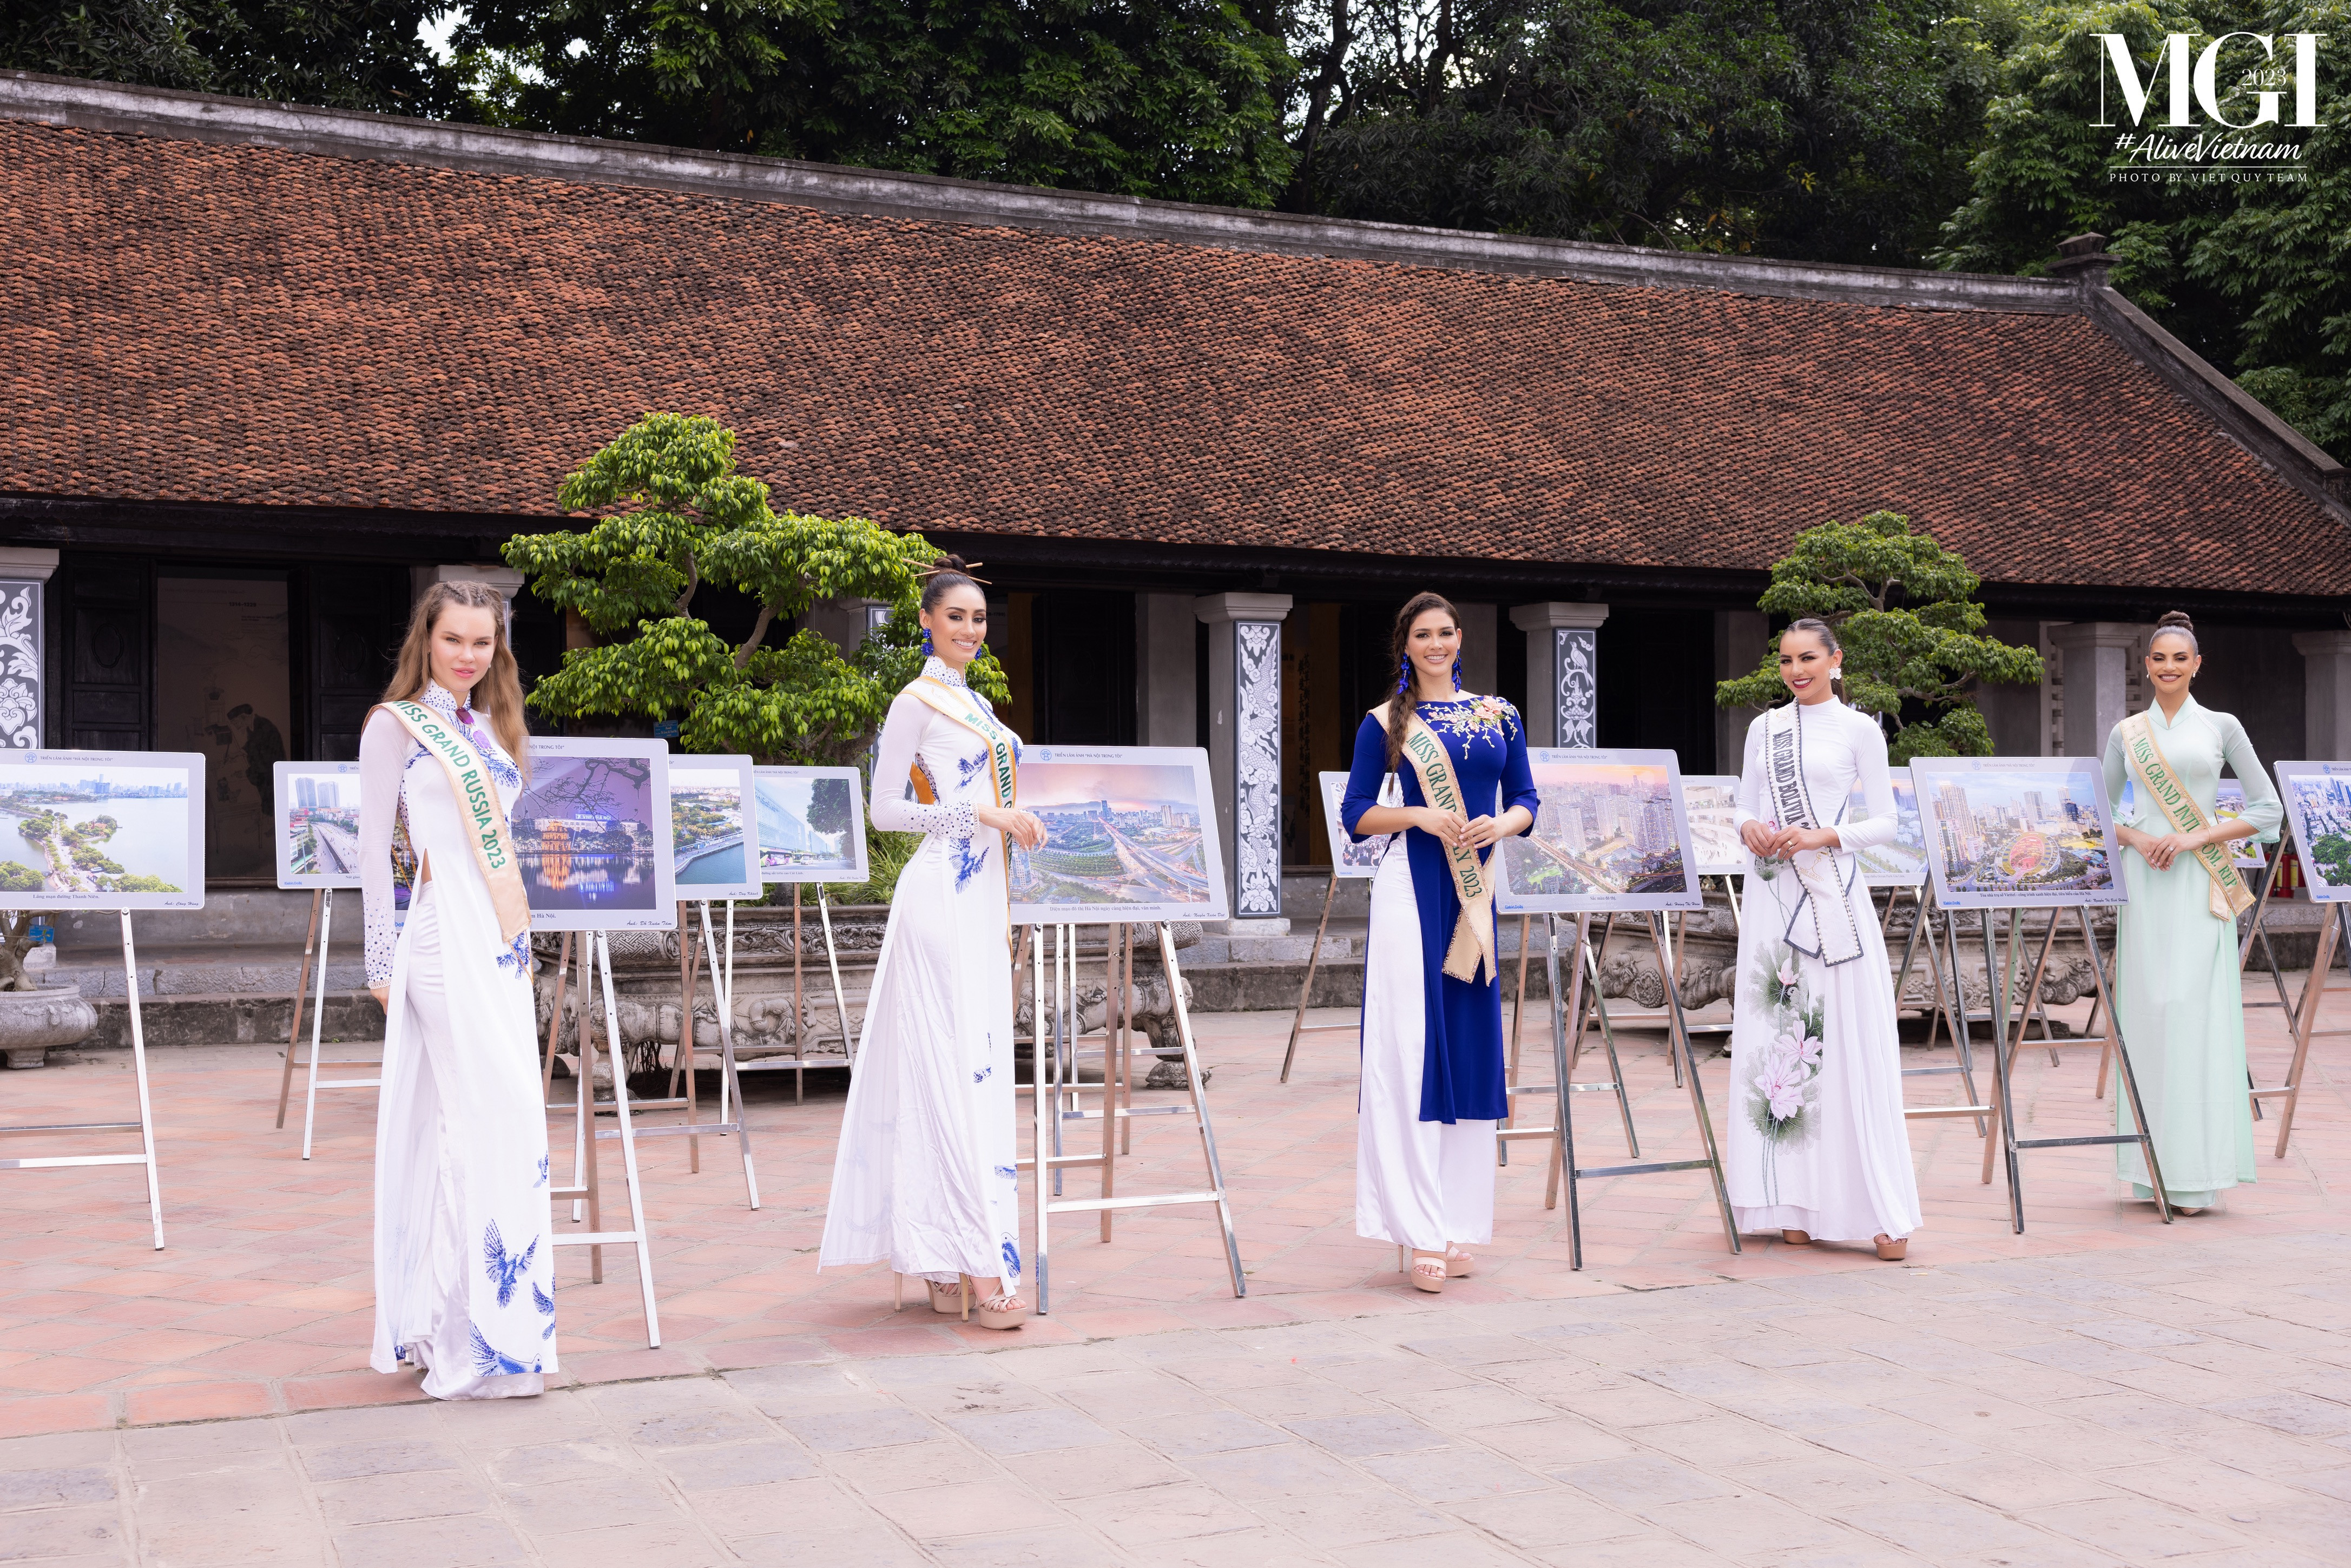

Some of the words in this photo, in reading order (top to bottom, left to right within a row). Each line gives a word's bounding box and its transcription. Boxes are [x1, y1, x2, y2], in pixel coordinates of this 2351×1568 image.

[964, 713, 998, 740] MISS
[996, 742, 1012, 798] GRAND
[1406, 731, 1439, 763] MISS
[1773, 728, 1793, 750] MISS
[392, 701, 428, 722] MISS
[422, 724, 470, 767] GRAND
[461, 769, 492, 830] RUSSIA
[481, 829, 506, 869] 2023
[1773, 750, 1795, 783] GRAND
[1778, 780, 1806, 826] BOLIVIA
[2132, 737, 2154, 764] MISS
[2145, 763, 2181, 806] GRAND
[2217, 864, 2237, 887] REP
[1459, 865, 1482, 898] 2023
